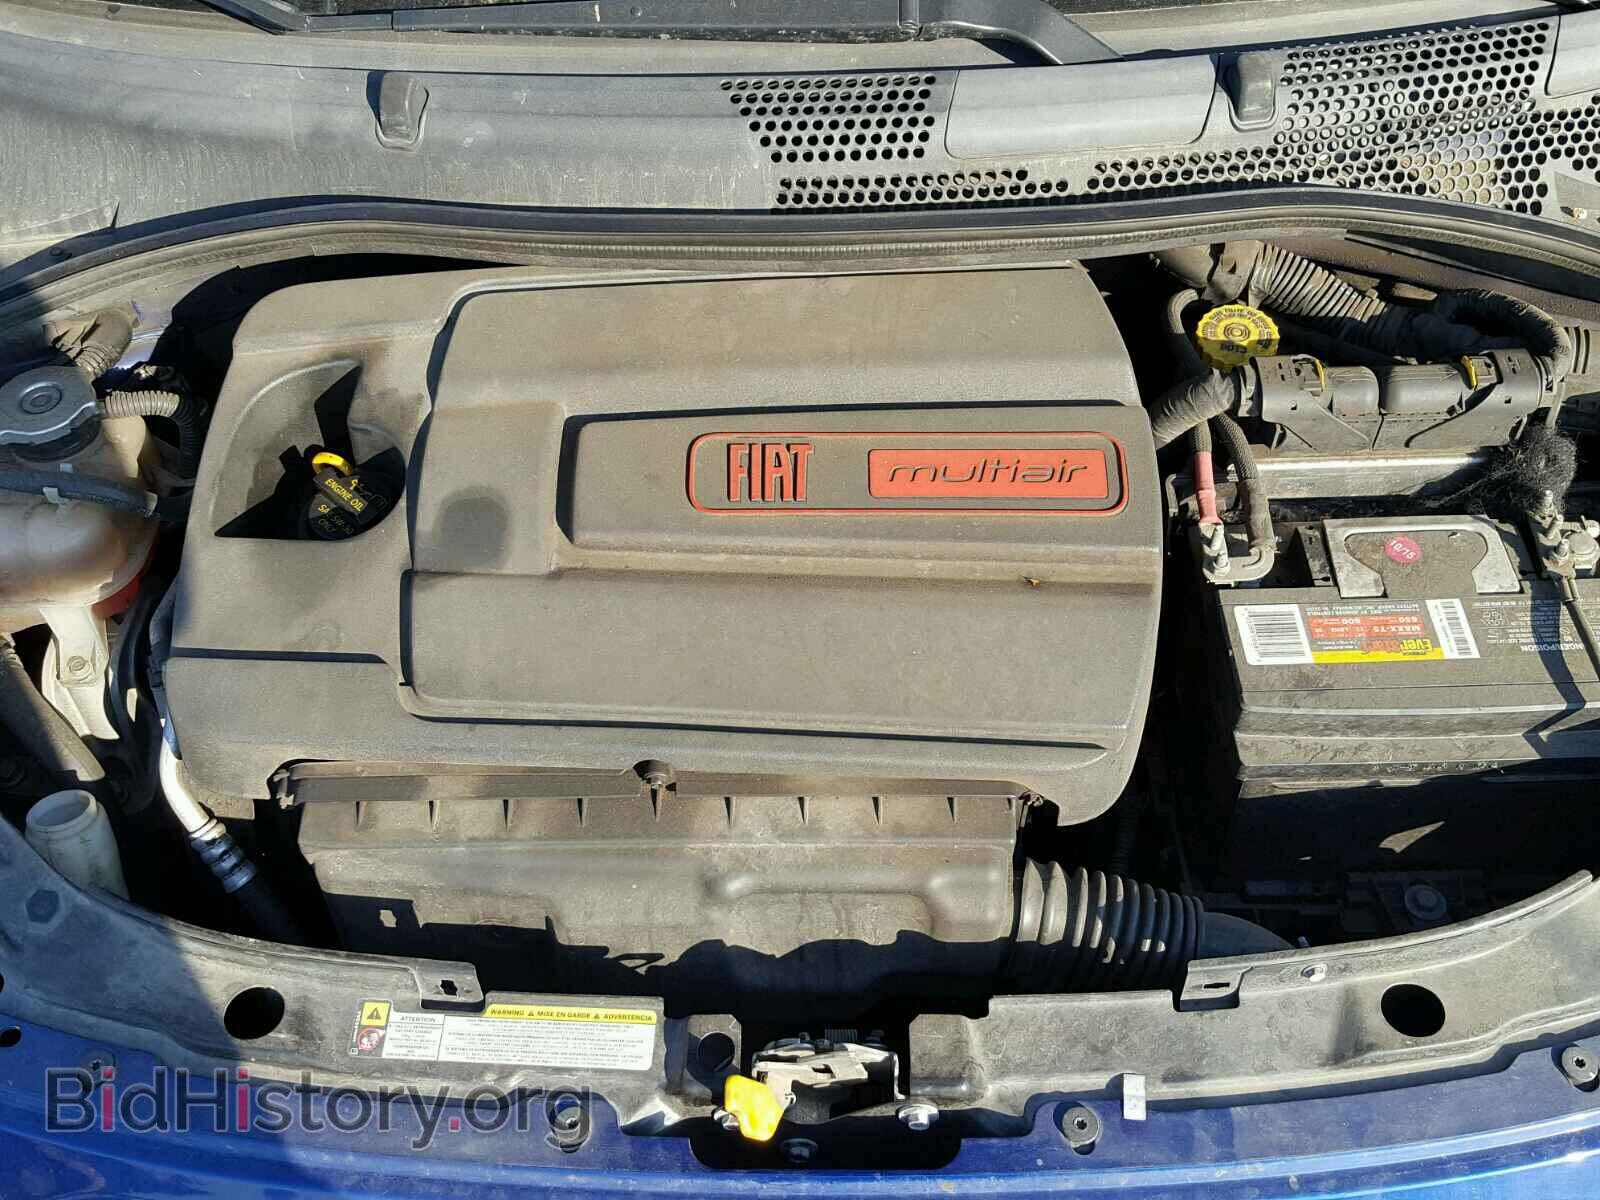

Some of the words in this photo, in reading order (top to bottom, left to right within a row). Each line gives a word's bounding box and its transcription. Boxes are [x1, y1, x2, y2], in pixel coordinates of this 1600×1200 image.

[727, 443, 815, 503] FIAT
[888, 458, 1088, 483] multiair
[324, 478, 353, 500] ENGINE
[350, 498, 364, 512] OIL
[604, 1013, 652, 1021] ADVERTENCIA
